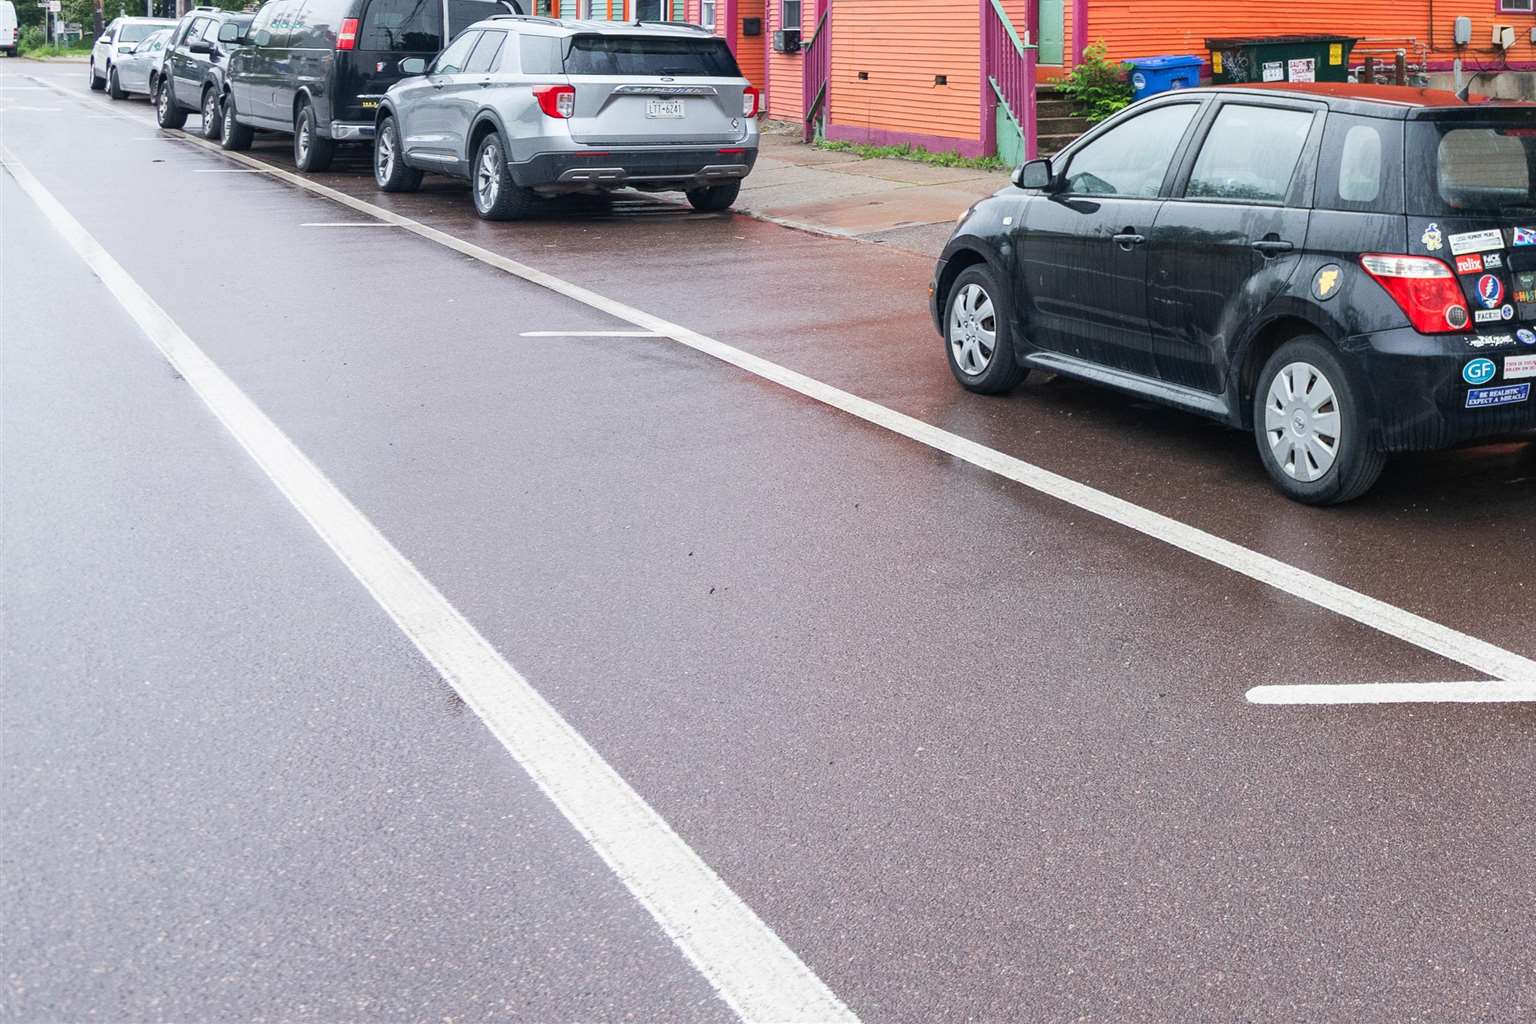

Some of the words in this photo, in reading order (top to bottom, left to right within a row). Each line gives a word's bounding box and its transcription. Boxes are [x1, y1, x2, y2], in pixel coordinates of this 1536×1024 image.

[1457, 257, 1482, 272] relix
[1468, 363, 1491, 378] GF
[1469, 398, 1493, 406] EXPECT
